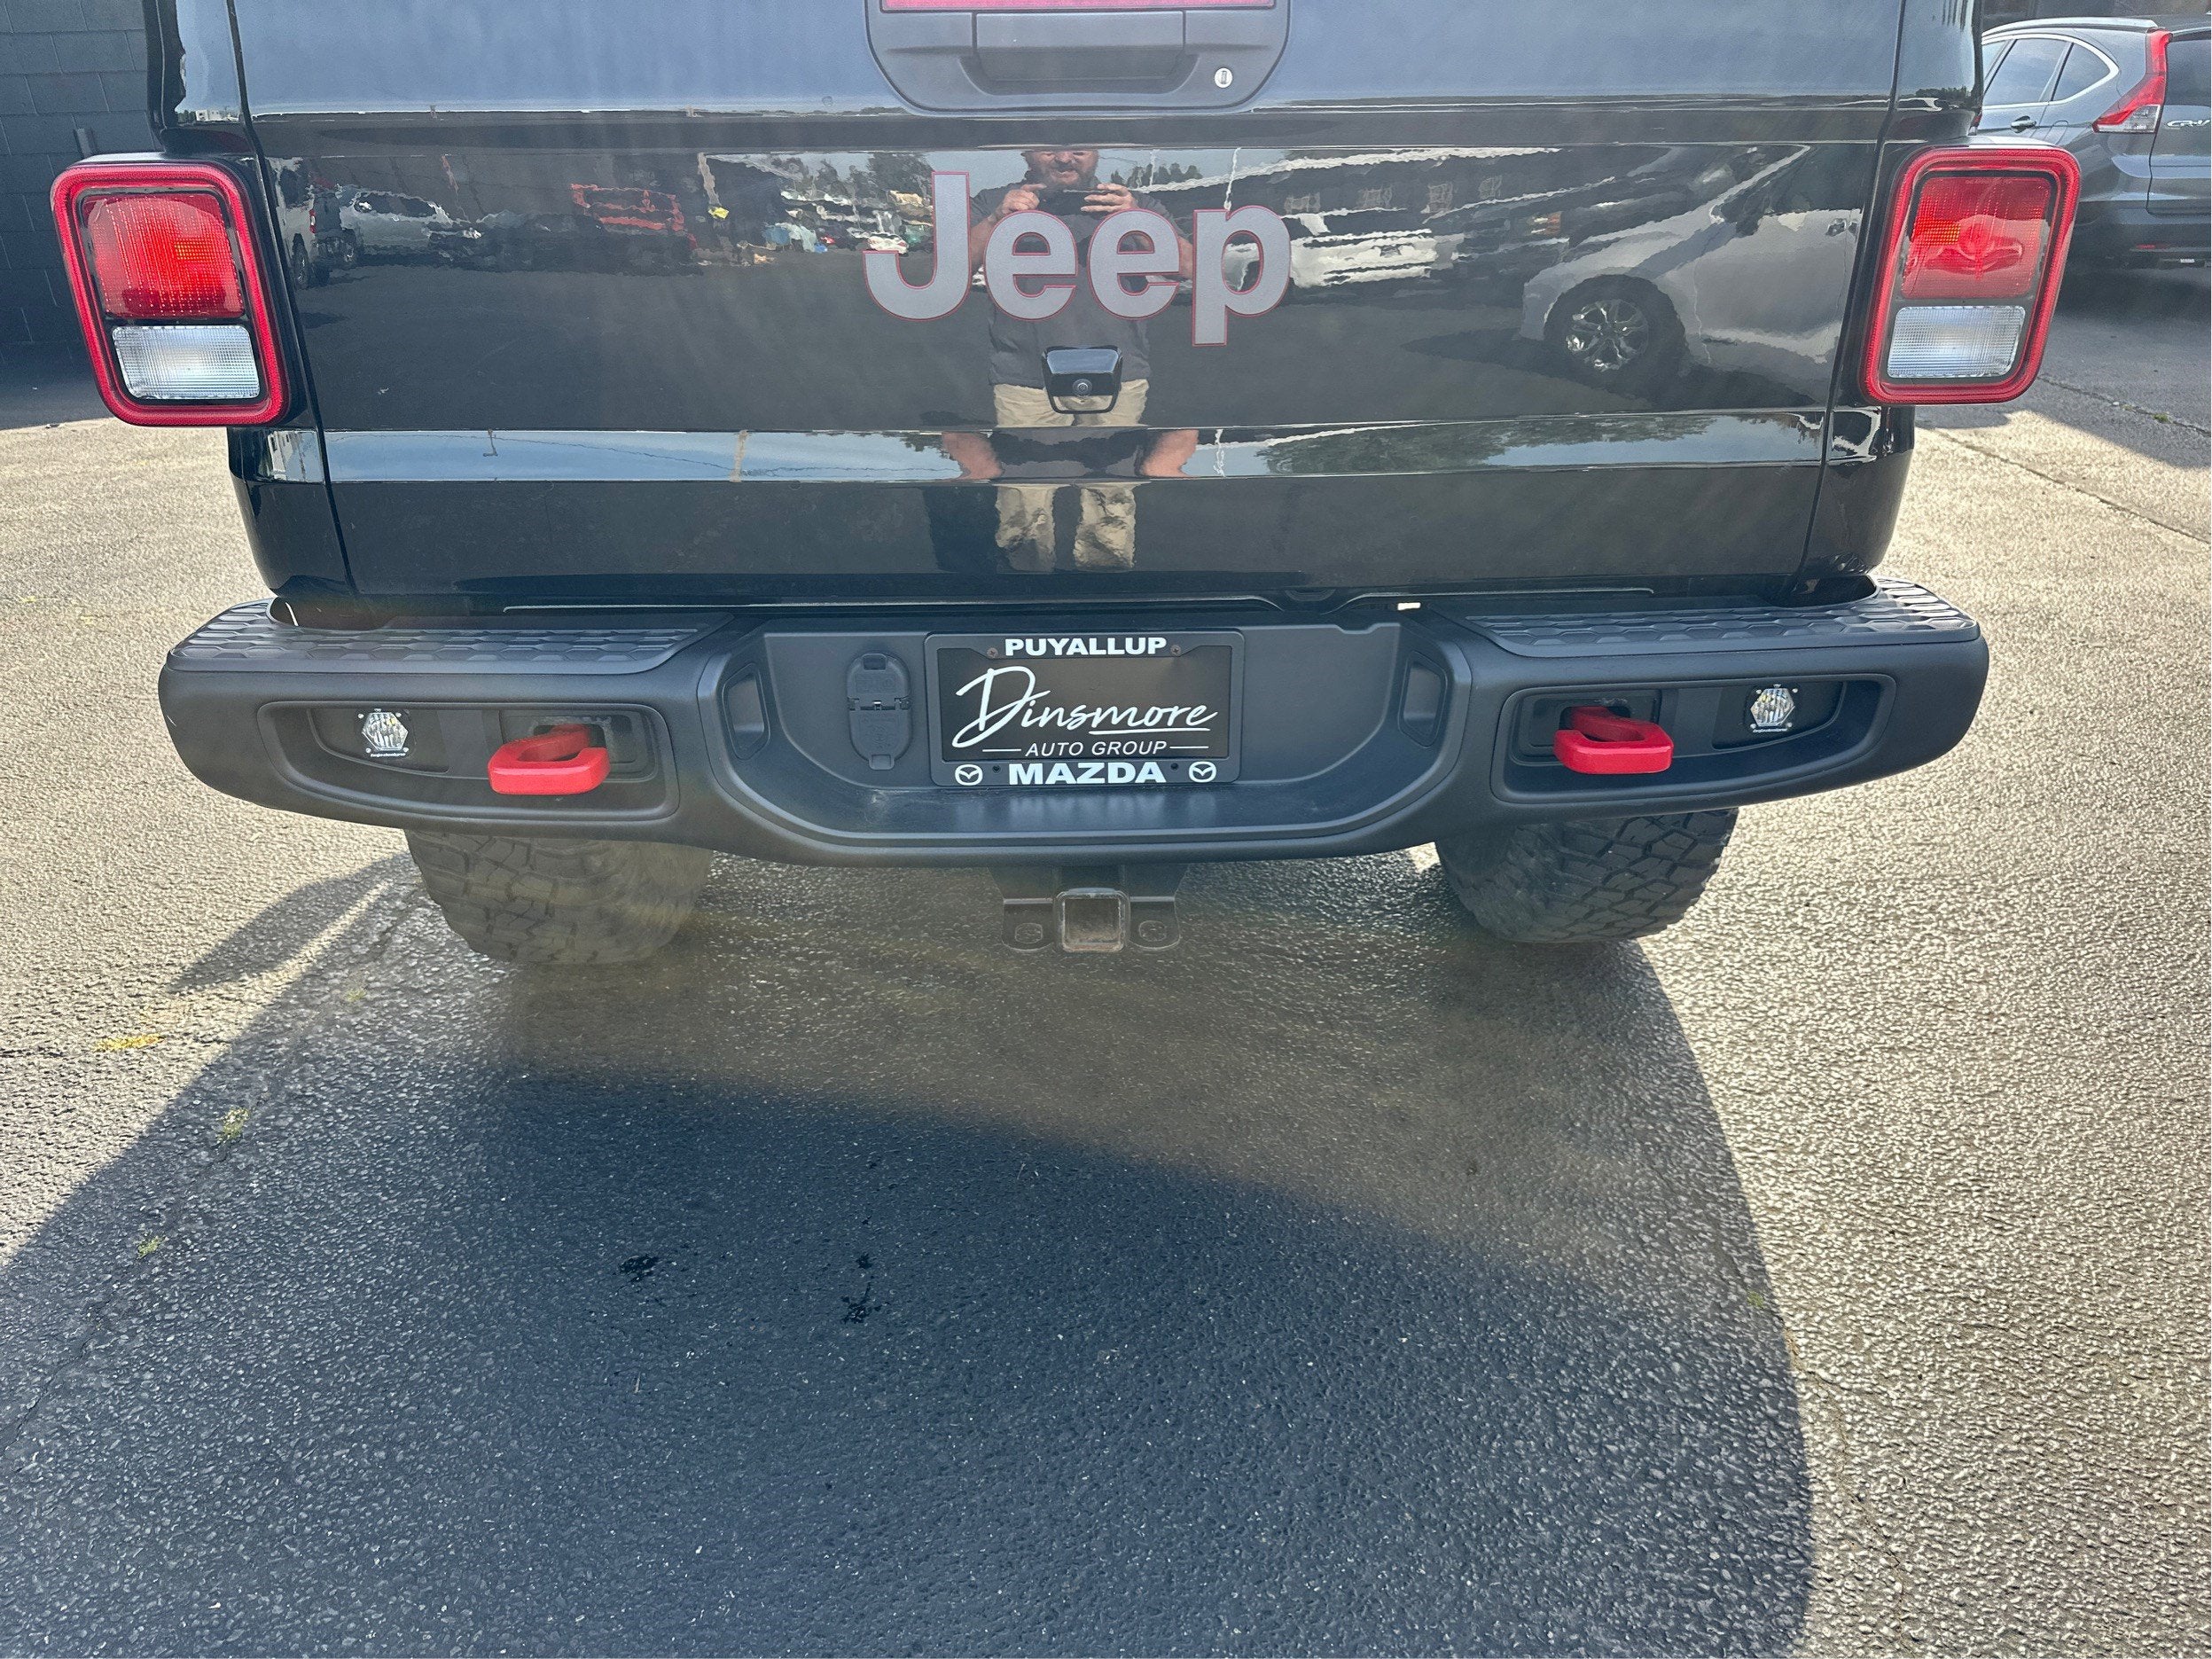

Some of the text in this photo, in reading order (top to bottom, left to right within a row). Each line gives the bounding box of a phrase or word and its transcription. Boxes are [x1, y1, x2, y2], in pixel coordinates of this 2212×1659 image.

[862, 171, 1292, 347] Jeep
[1004, 637, 1167, 656] PUYALLUP
[951, 665, 1218, 748] Dinsmore
[1025, 740, 1167, 757] AUTO GROUP
[1008, 762, 1167, 785] MAZDA
